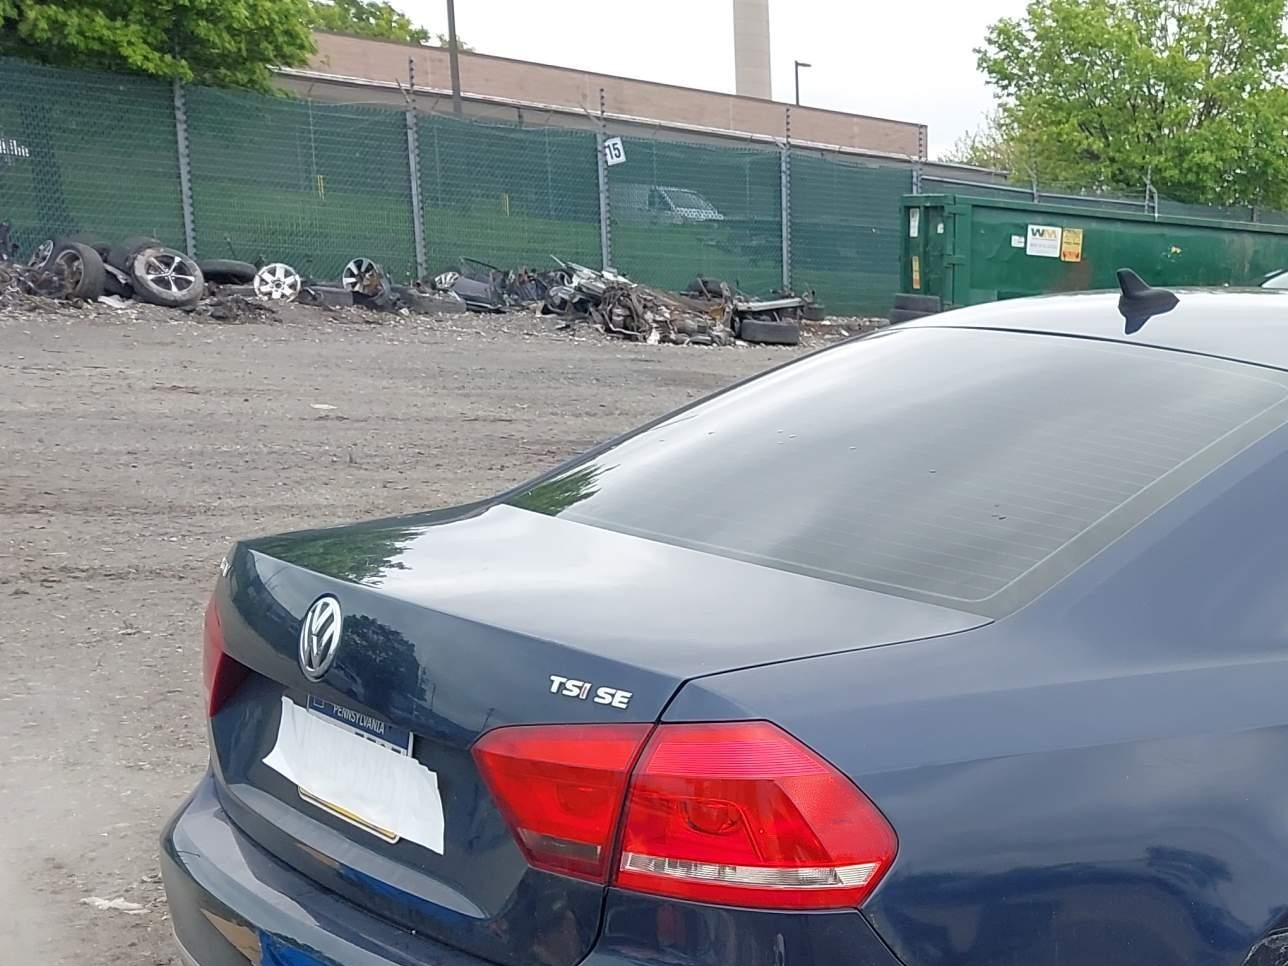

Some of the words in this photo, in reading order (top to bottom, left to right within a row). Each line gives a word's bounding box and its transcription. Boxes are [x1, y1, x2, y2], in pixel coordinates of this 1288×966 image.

[607, 142, 621, 160] 15
[1030, 227, 1057, 239] WM
[550, 675, 592, 699] TSI
[594, 686, 633, 709] SE
[332, 704, 385, 735] PENNSYLVANIA
